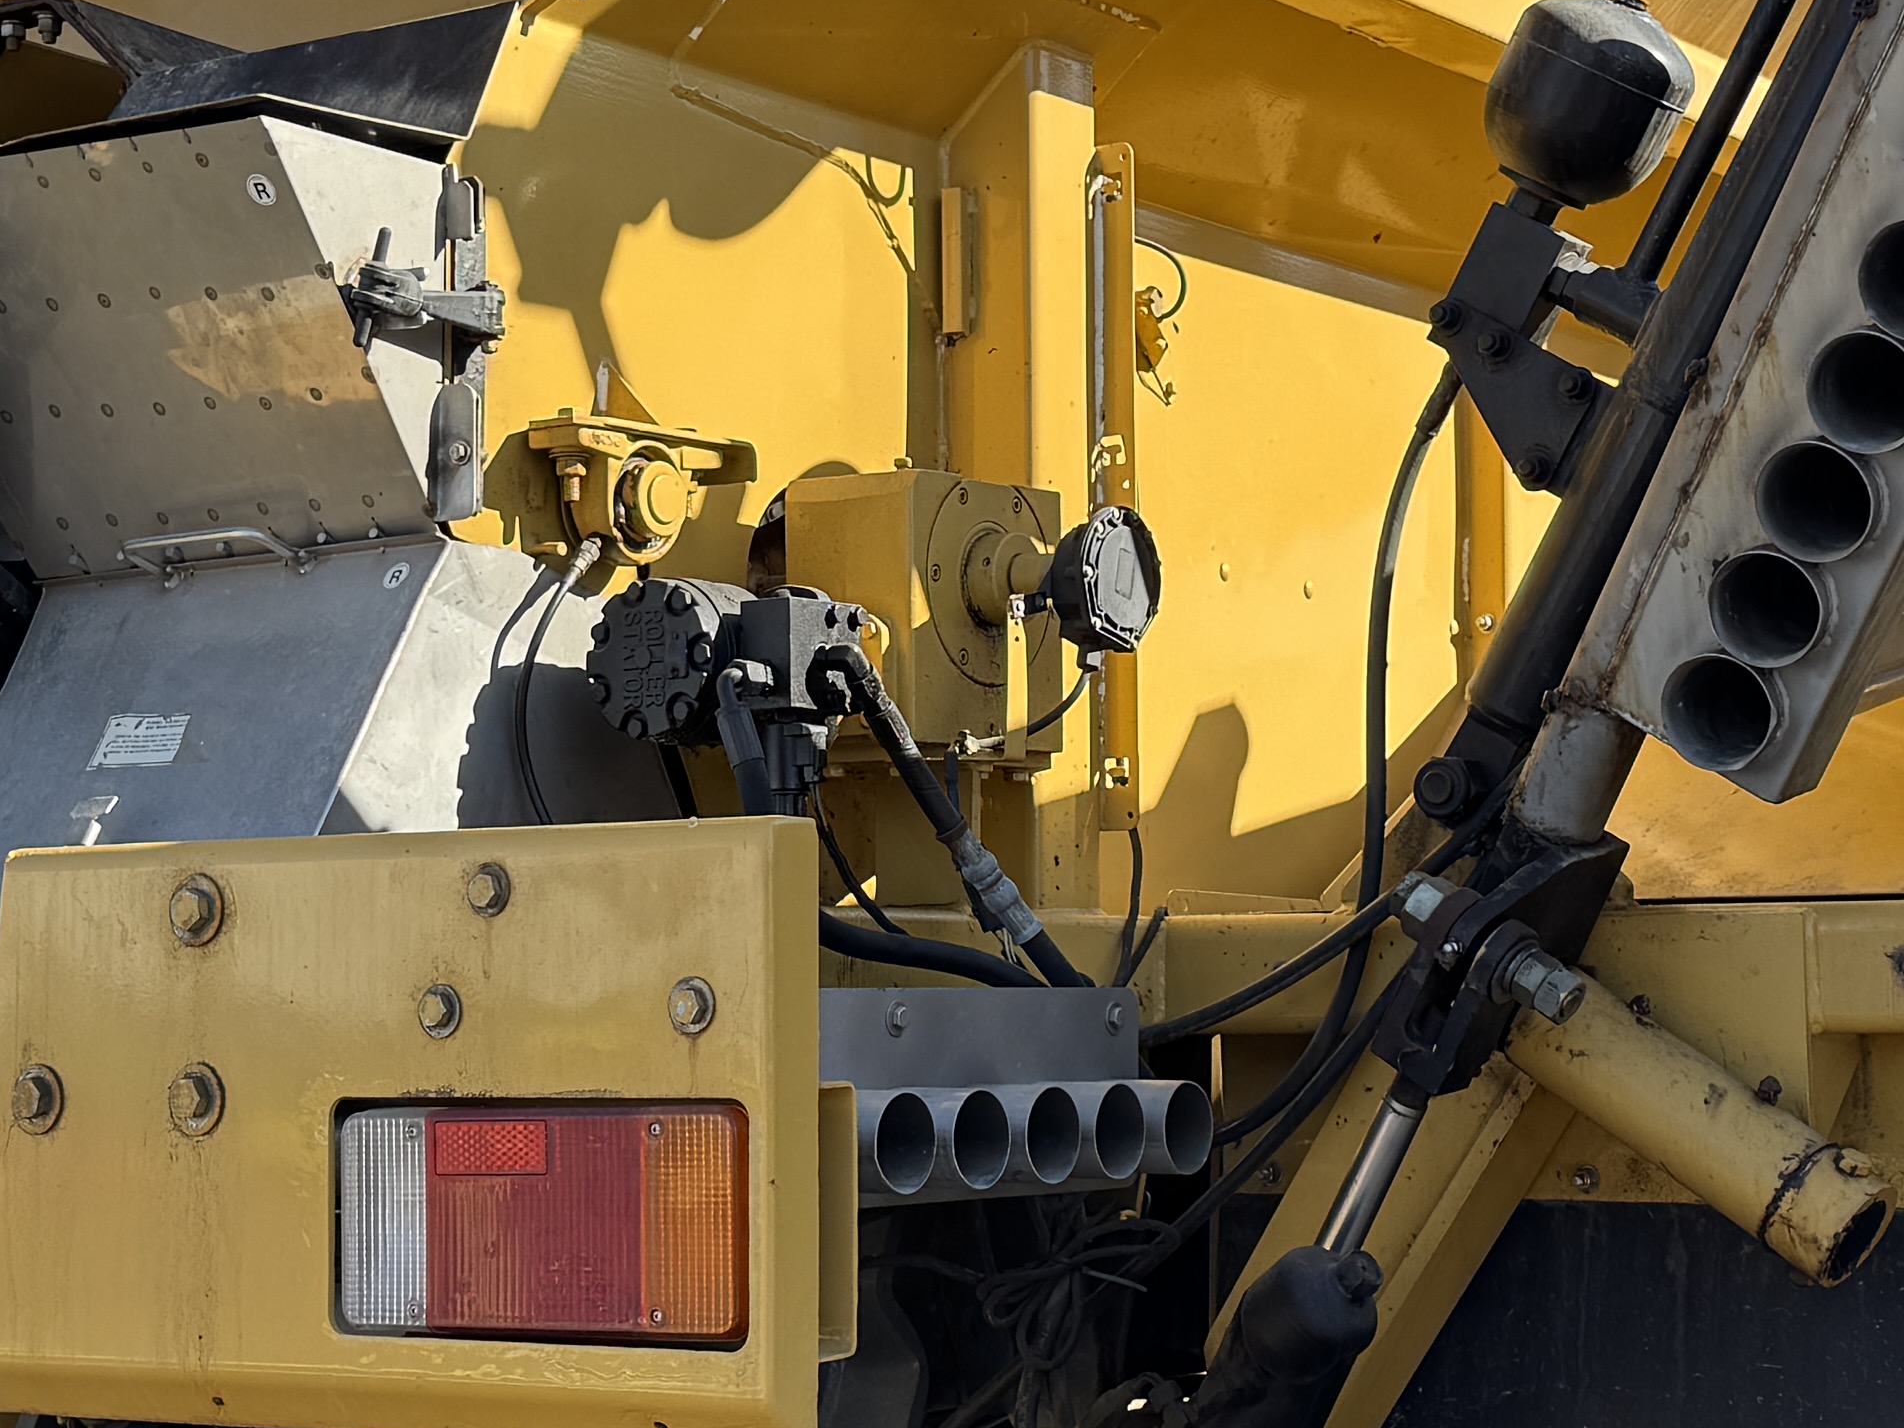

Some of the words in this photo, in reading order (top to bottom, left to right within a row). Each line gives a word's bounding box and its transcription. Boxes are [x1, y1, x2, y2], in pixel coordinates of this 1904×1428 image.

[253, 182, 271, 200] R
[388, 569, 403, 584] R
[623, 610, 644, 711] STATOR
[645, 609, 666, 709] ROLLER
